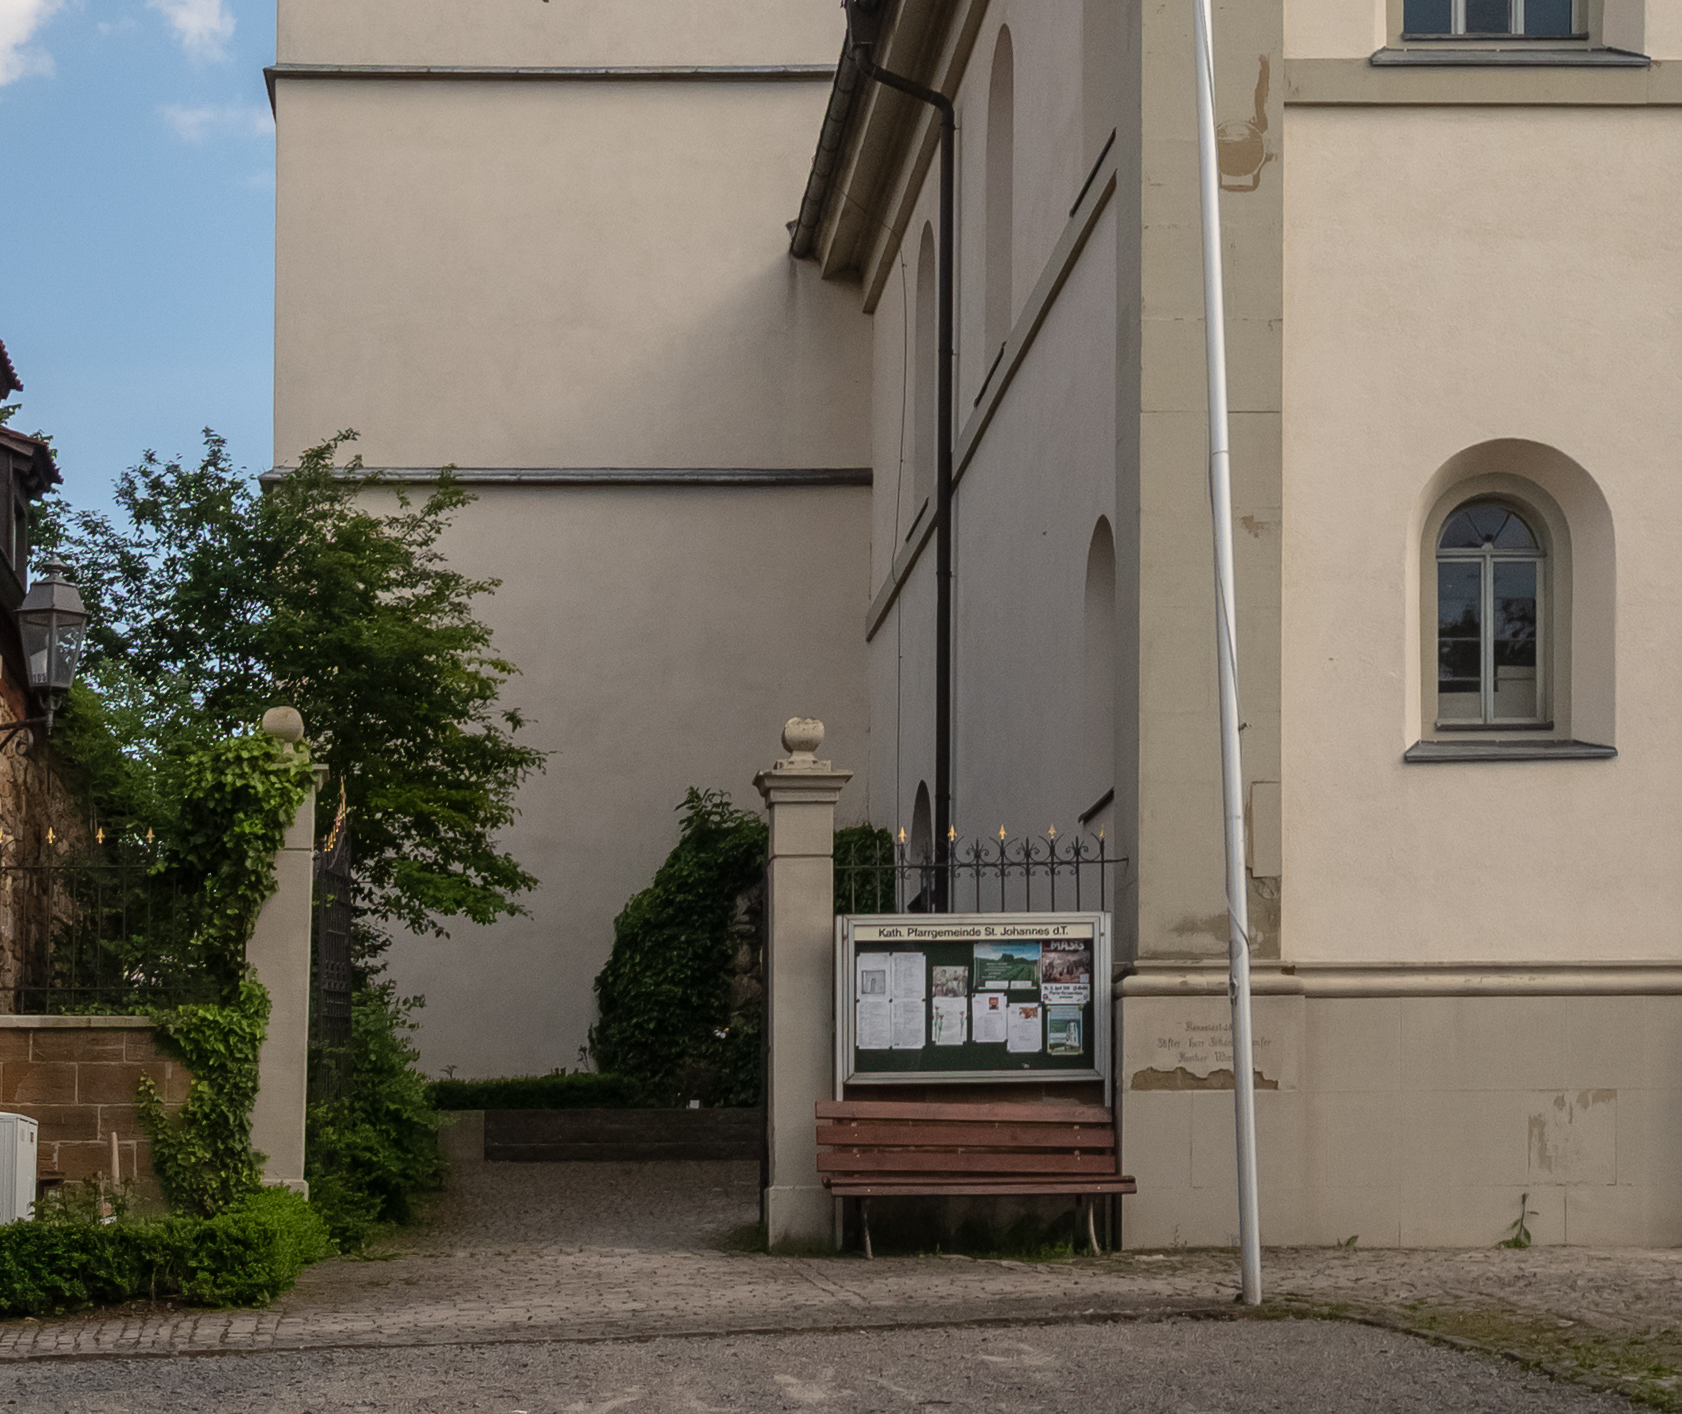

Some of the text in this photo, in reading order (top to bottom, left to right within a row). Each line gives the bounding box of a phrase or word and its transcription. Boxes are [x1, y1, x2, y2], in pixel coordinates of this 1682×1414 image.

[878, 927, 904, 938] Kath.
[907, 926, 981, 939] Pfarrgemeinde
[984, 926, 997, 937] St.
[1000, 926, 1050, 937] Johannes
